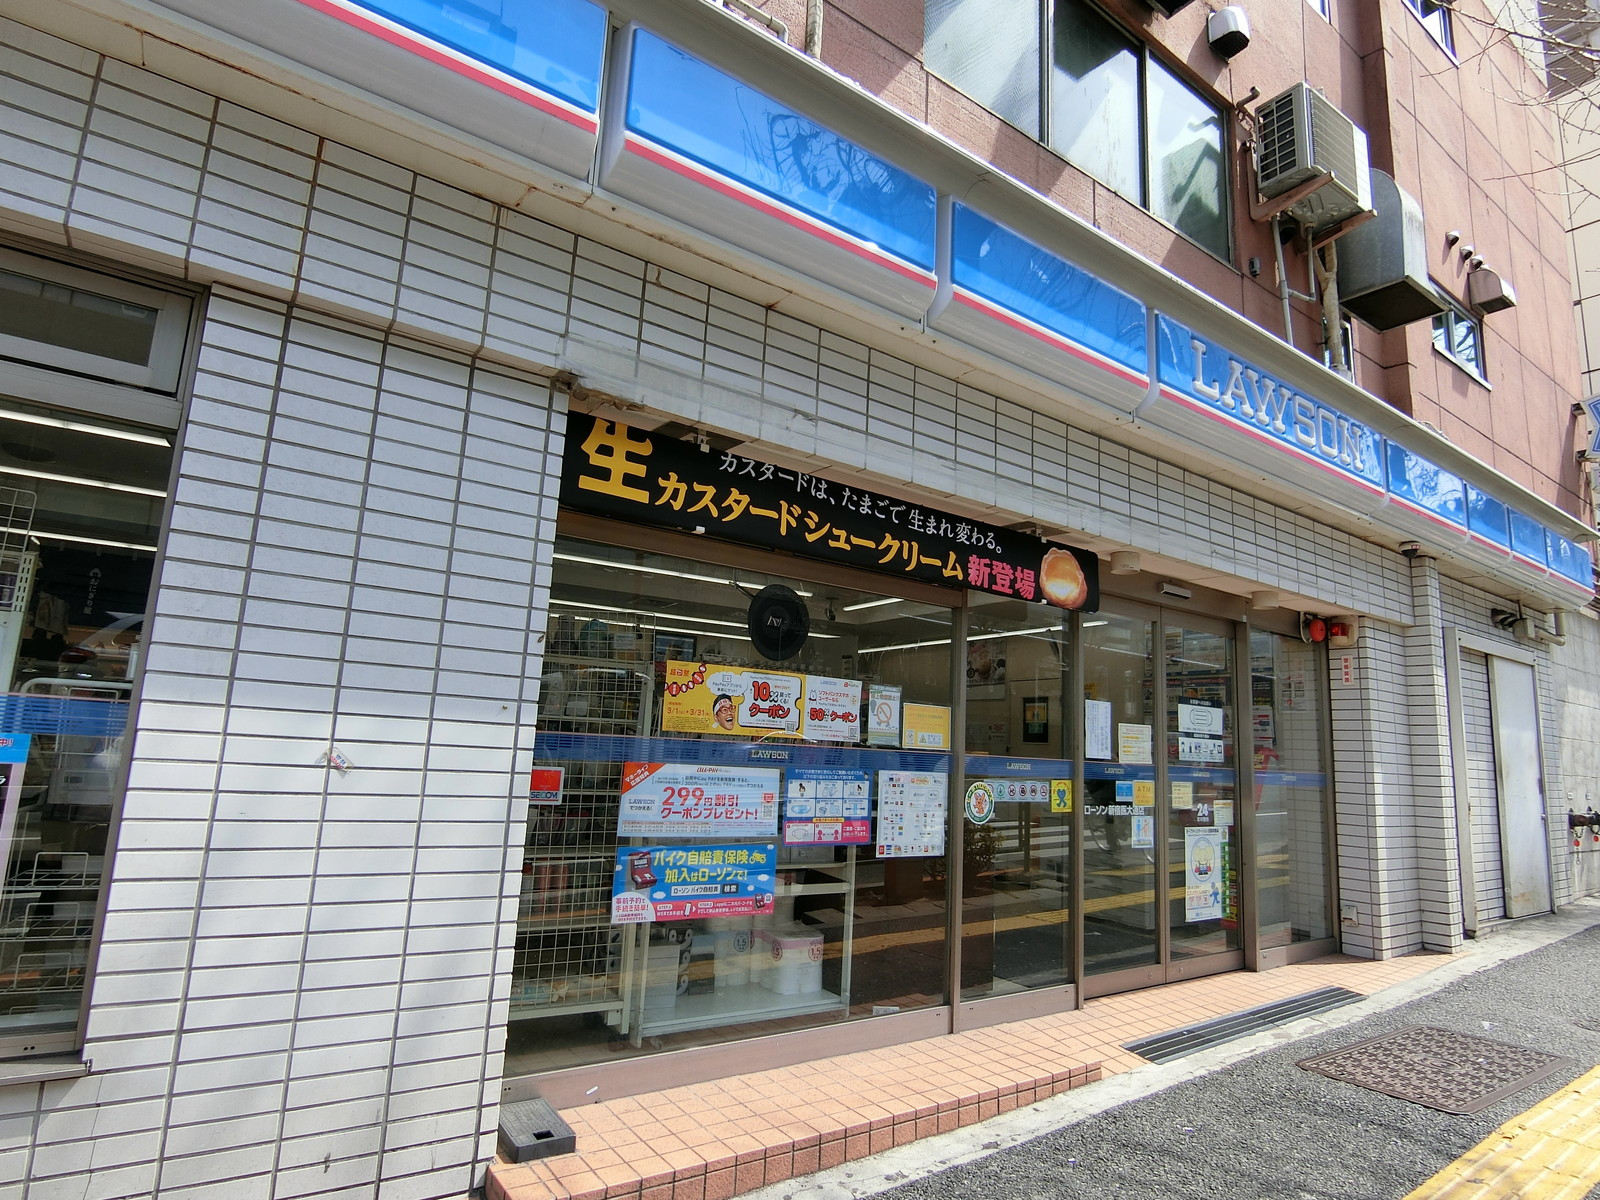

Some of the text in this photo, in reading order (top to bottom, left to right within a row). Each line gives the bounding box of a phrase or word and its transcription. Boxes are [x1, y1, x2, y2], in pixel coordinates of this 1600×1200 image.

[1191, 338, 1364, 473] LAWSON
[578, 417, 1037, 601] 生 カスタードシュークリーム 新登場
[749, 703, 790, 718] クーポン
[830, 710, 857, 723] クーポン
[751, 750, 789, 759] LAWSON
[1006, 762, 1031, 770] LAWSON
[661, 808, 758, 820] クーポンプレゼント!
[1197, 803, 1209, 816] 24
[653, 850, 749, 867] バイク自賠責保険
[665, 867, 748, 883] 加入はローソンで!
